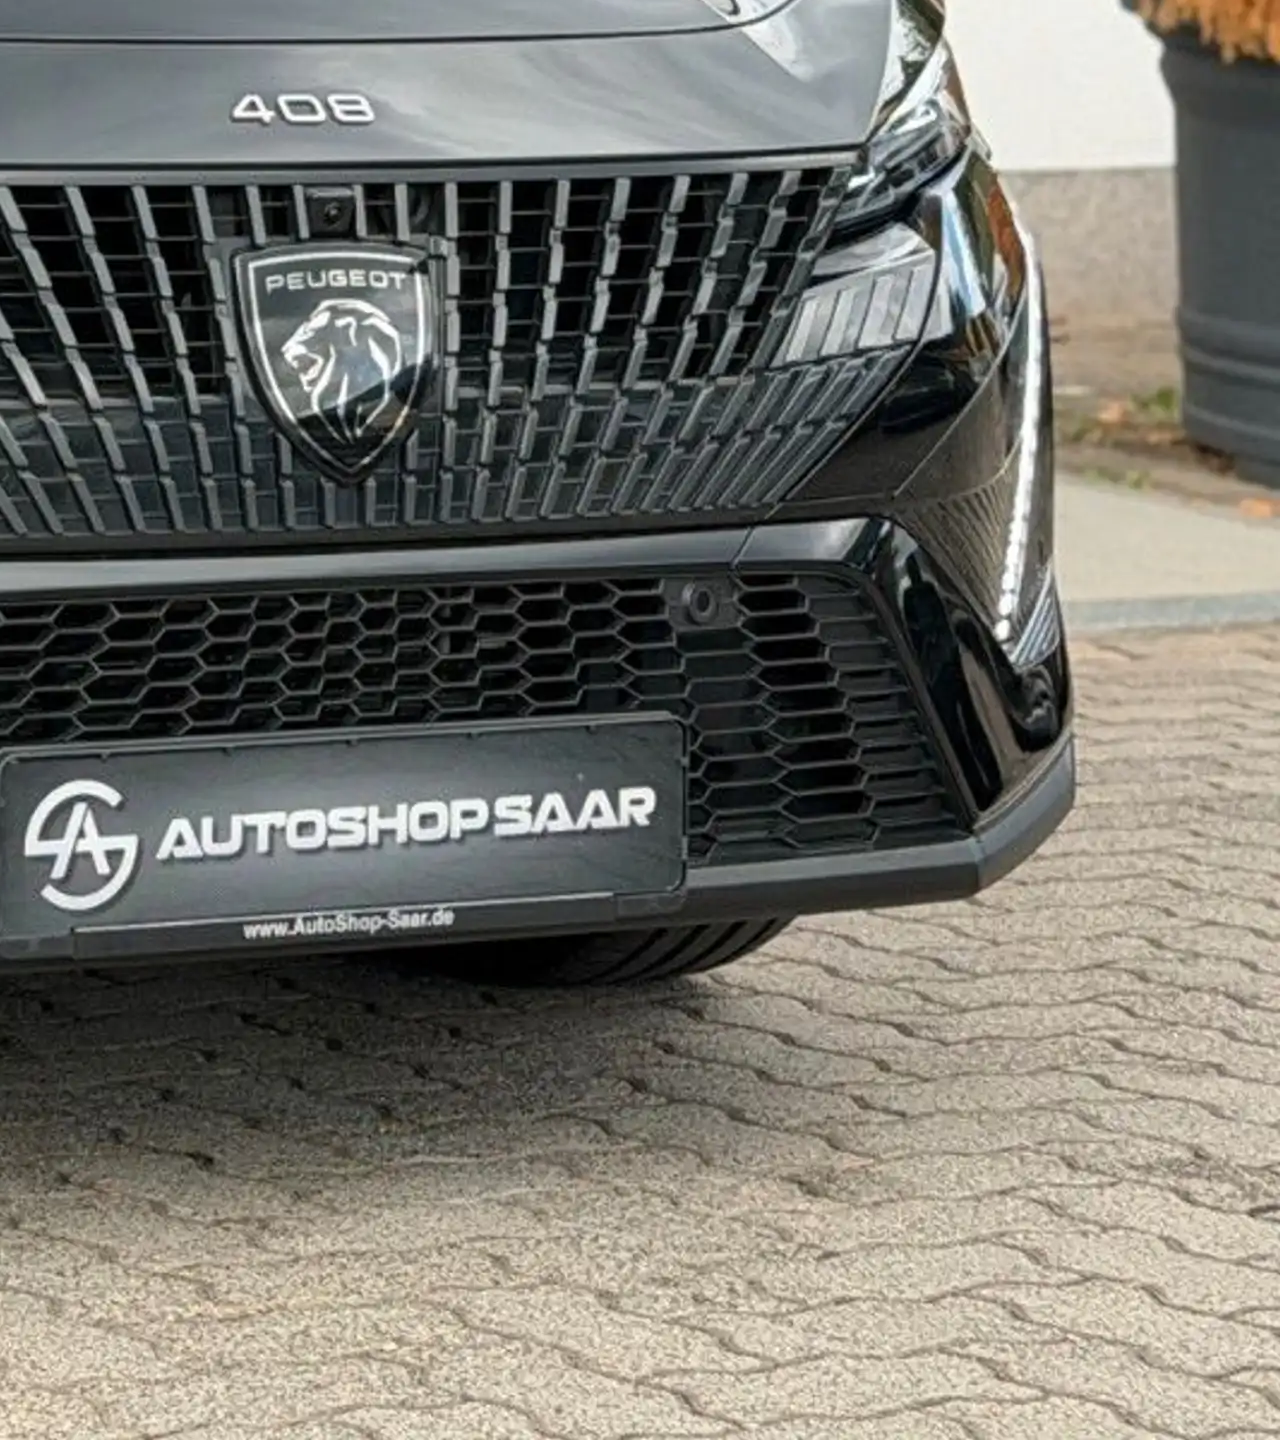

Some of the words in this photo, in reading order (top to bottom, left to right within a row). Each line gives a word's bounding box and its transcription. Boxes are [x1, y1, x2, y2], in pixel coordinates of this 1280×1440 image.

[231, 93, 375, 123] 408
[265, 269, 407, 294] PEUGEOT
[243, 907, 455, 940] www.AutoShop-Saar.de
